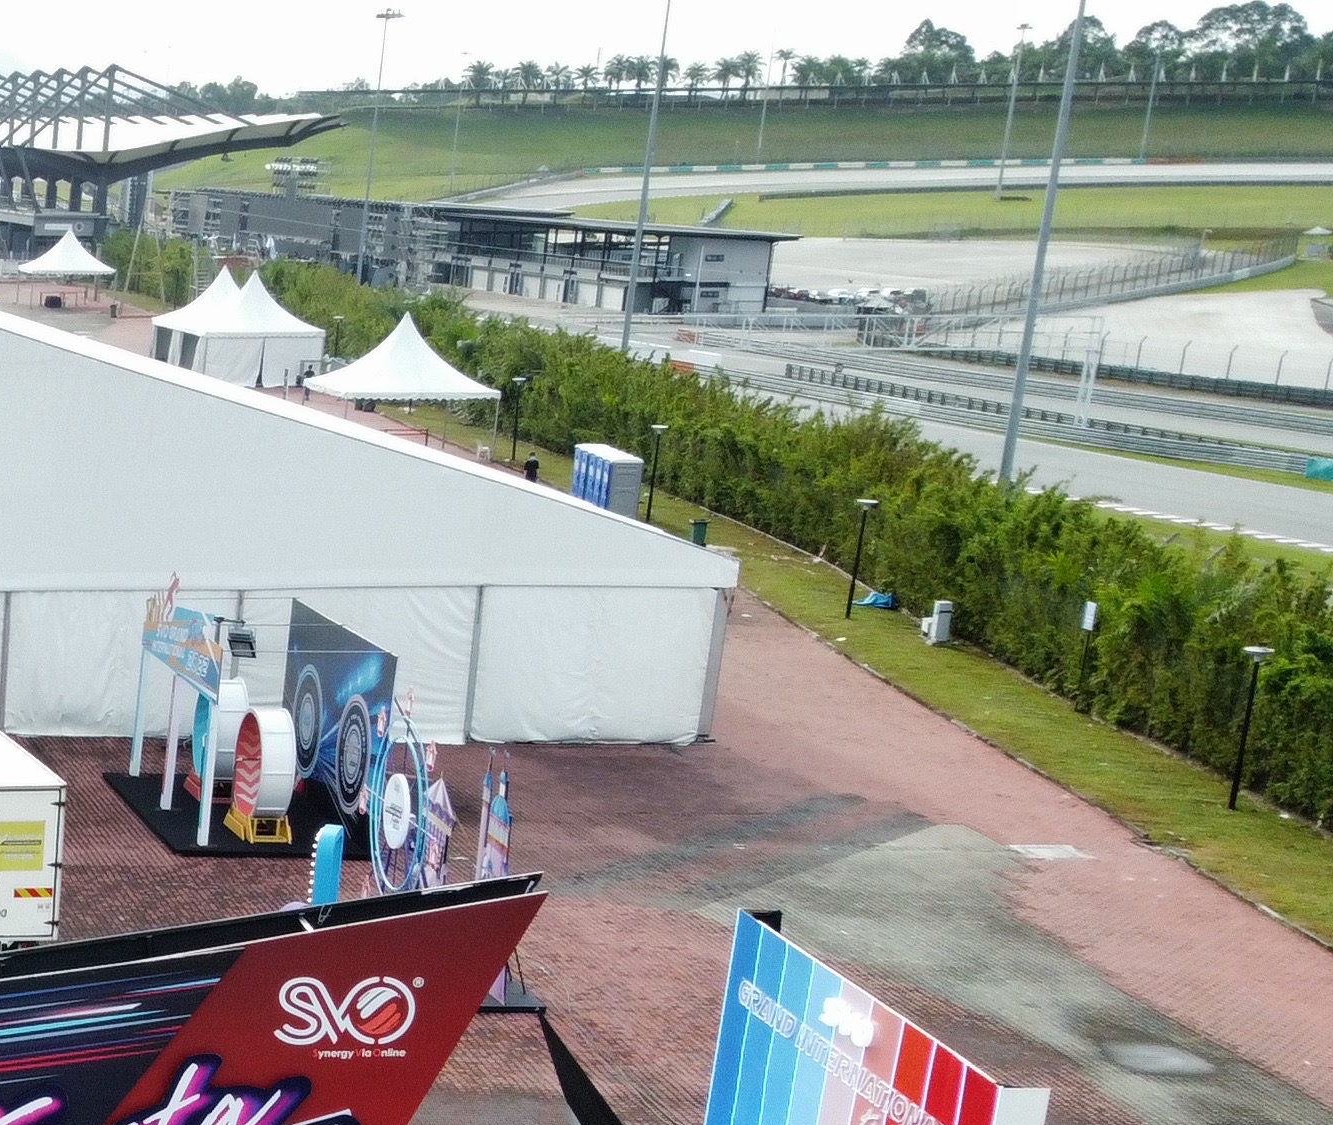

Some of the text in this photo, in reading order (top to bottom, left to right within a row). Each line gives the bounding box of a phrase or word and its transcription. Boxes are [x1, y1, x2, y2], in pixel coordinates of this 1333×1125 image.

[274, 977, 416, 1046] SVO
[738, 978, 797, 1039] GRAND
[312, 1048, 406, 1060] Synergy Via Online
